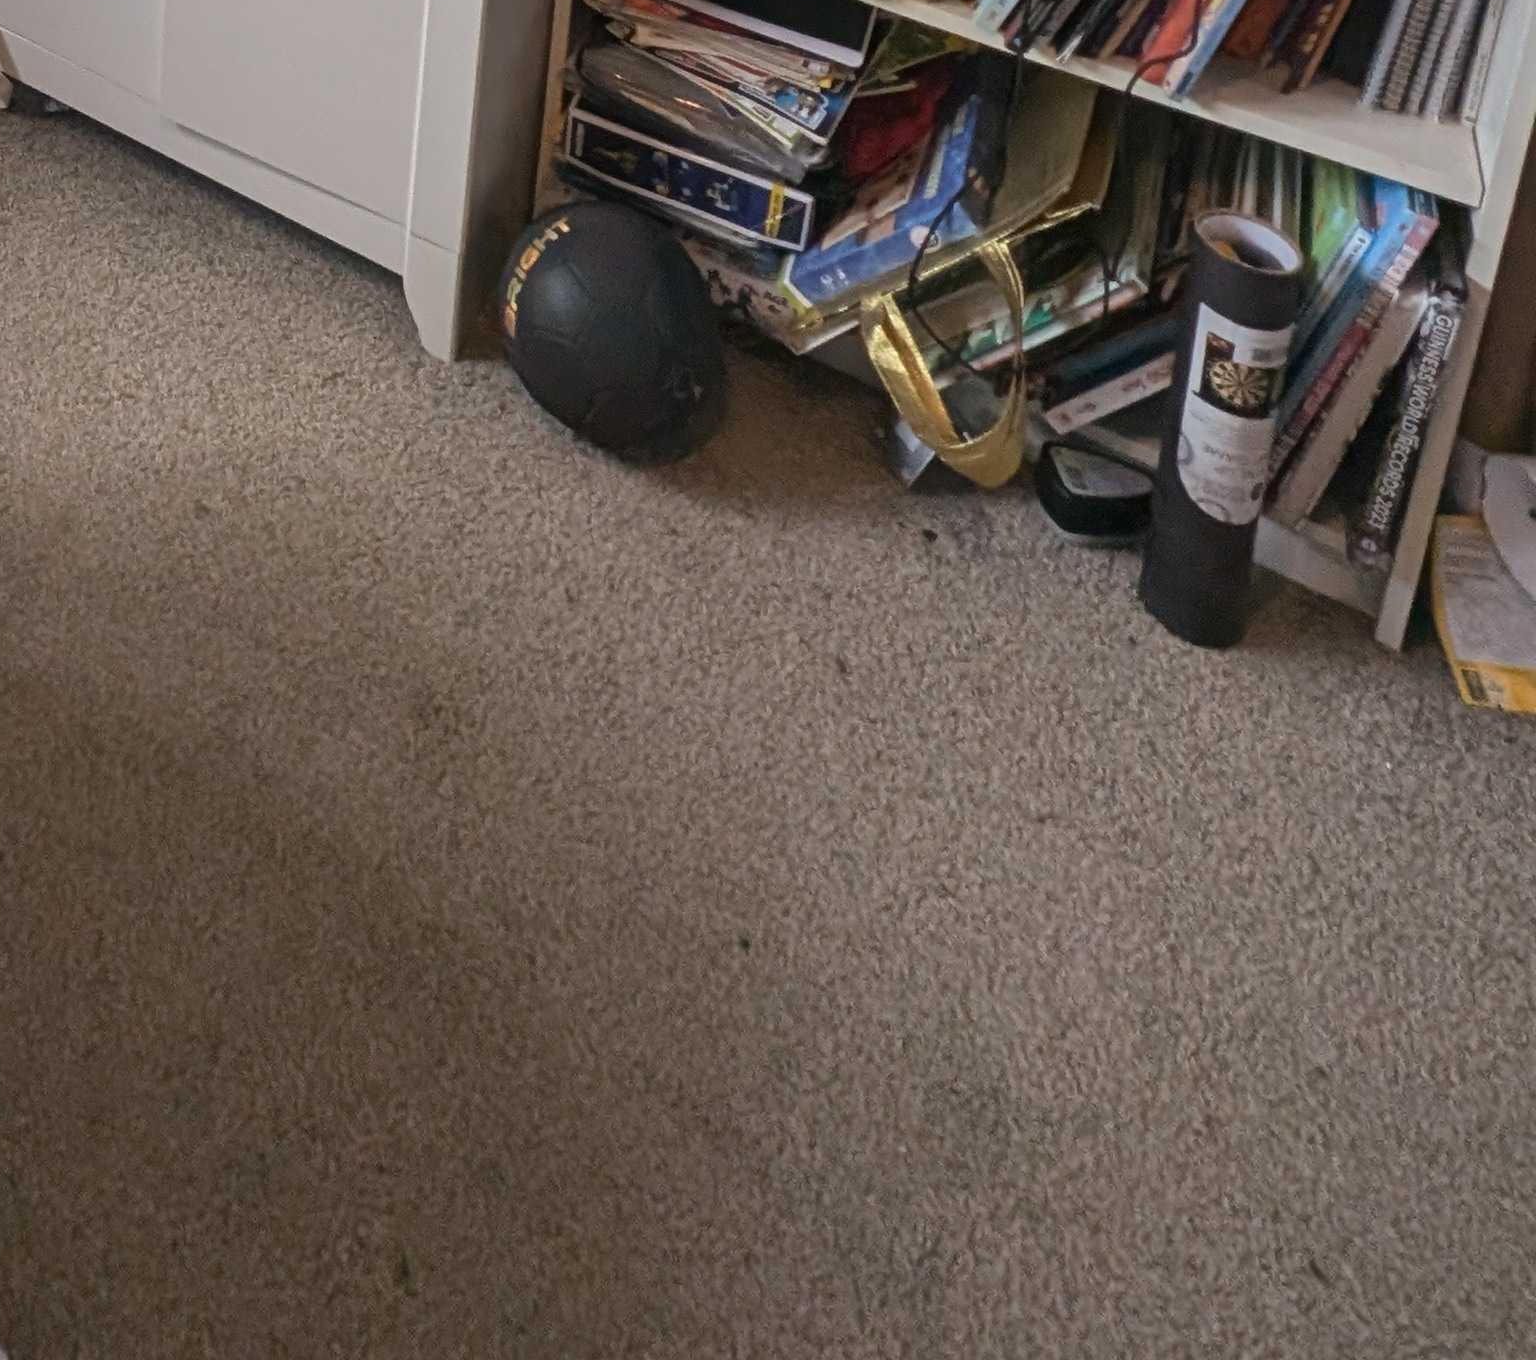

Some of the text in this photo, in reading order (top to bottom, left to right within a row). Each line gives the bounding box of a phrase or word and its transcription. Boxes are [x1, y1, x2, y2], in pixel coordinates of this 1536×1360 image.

[1416, 314, 1453, 385] GUINNESS
[1401, 382, 1437, 431] WORLD
[1379, 427, 1420, 498] RECORDS
